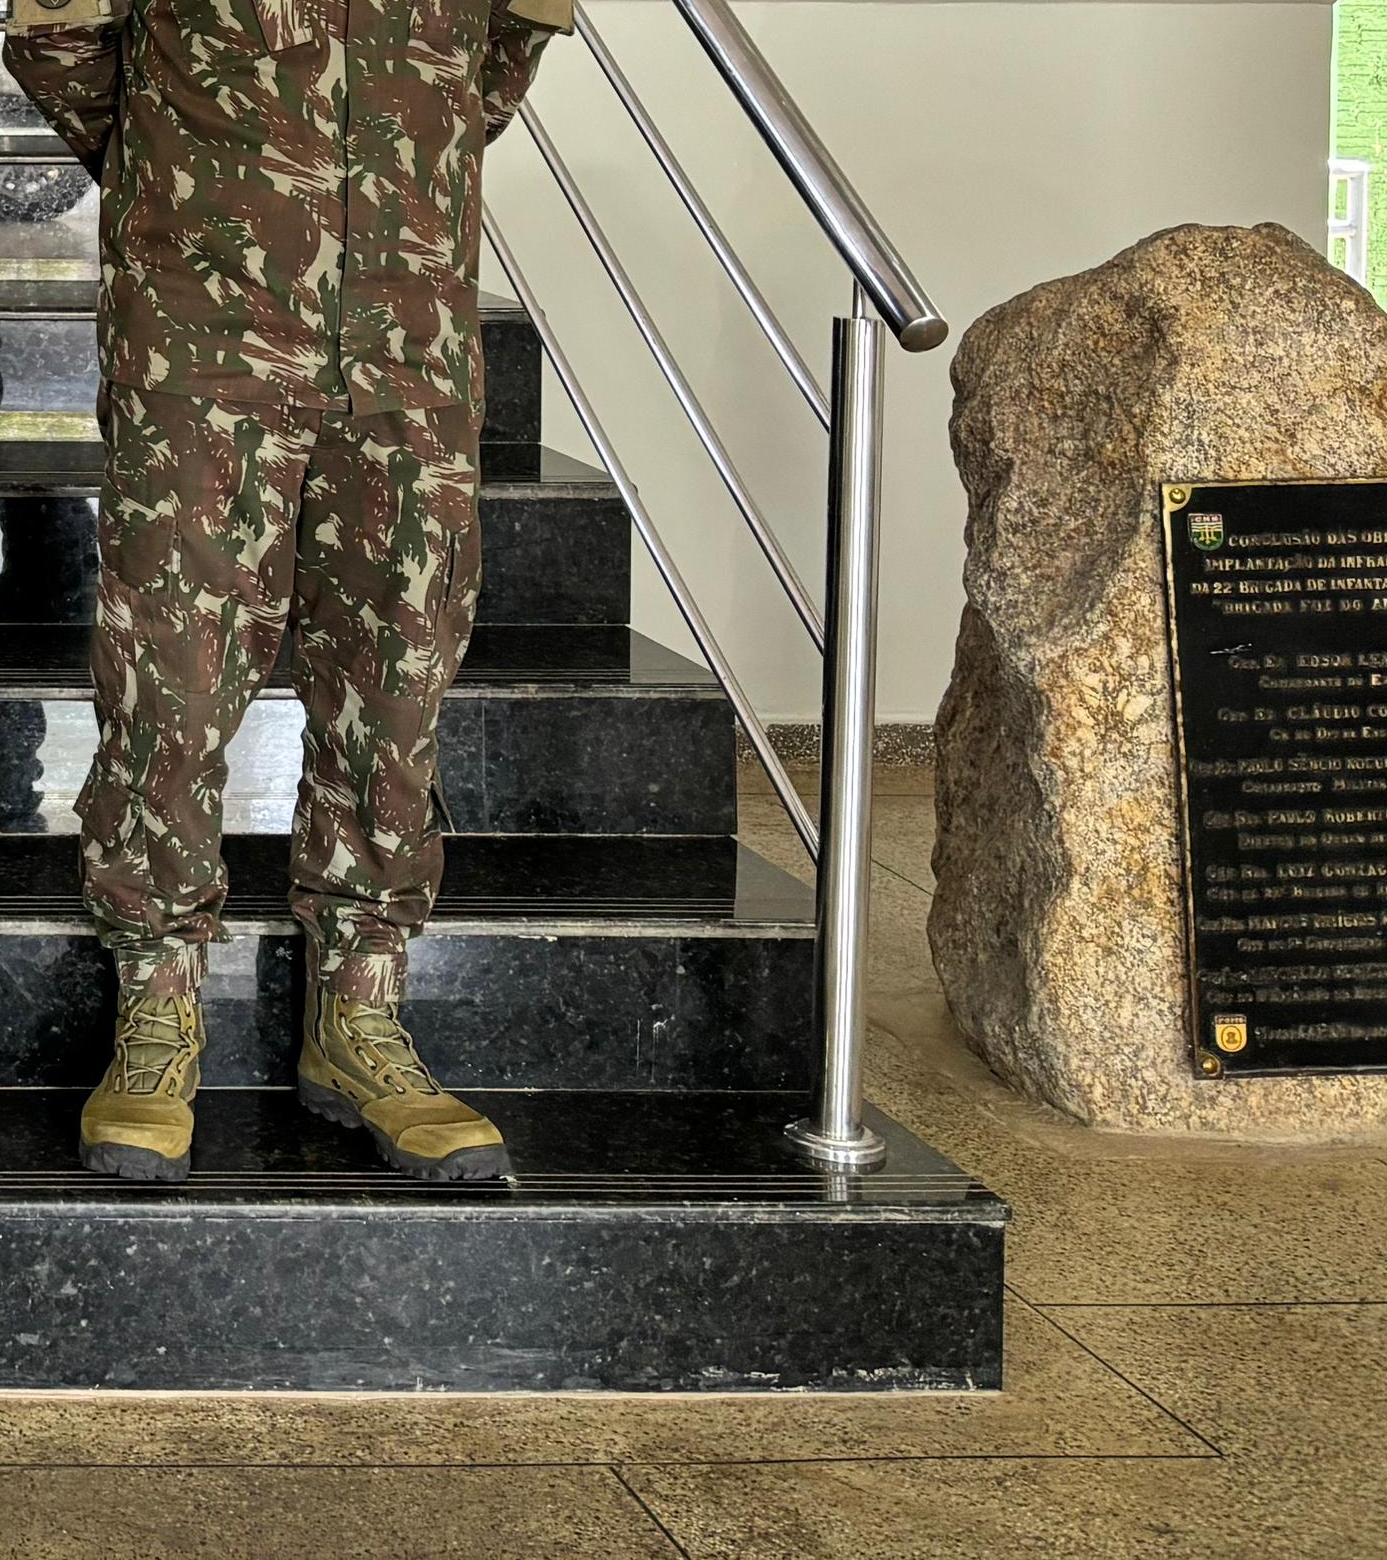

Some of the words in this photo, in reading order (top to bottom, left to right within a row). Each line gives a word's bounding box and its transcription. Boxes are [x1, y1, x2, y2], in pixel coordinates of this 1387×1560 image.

[1328, 532, 1357, 544] DAS
[1318, 557, 1335, 568] DA
[1340, 555, 1387, 568] INFRA
[1239, 581, 1302, 594] BRIGADA
[1307, 579, 1327, 591] DE
